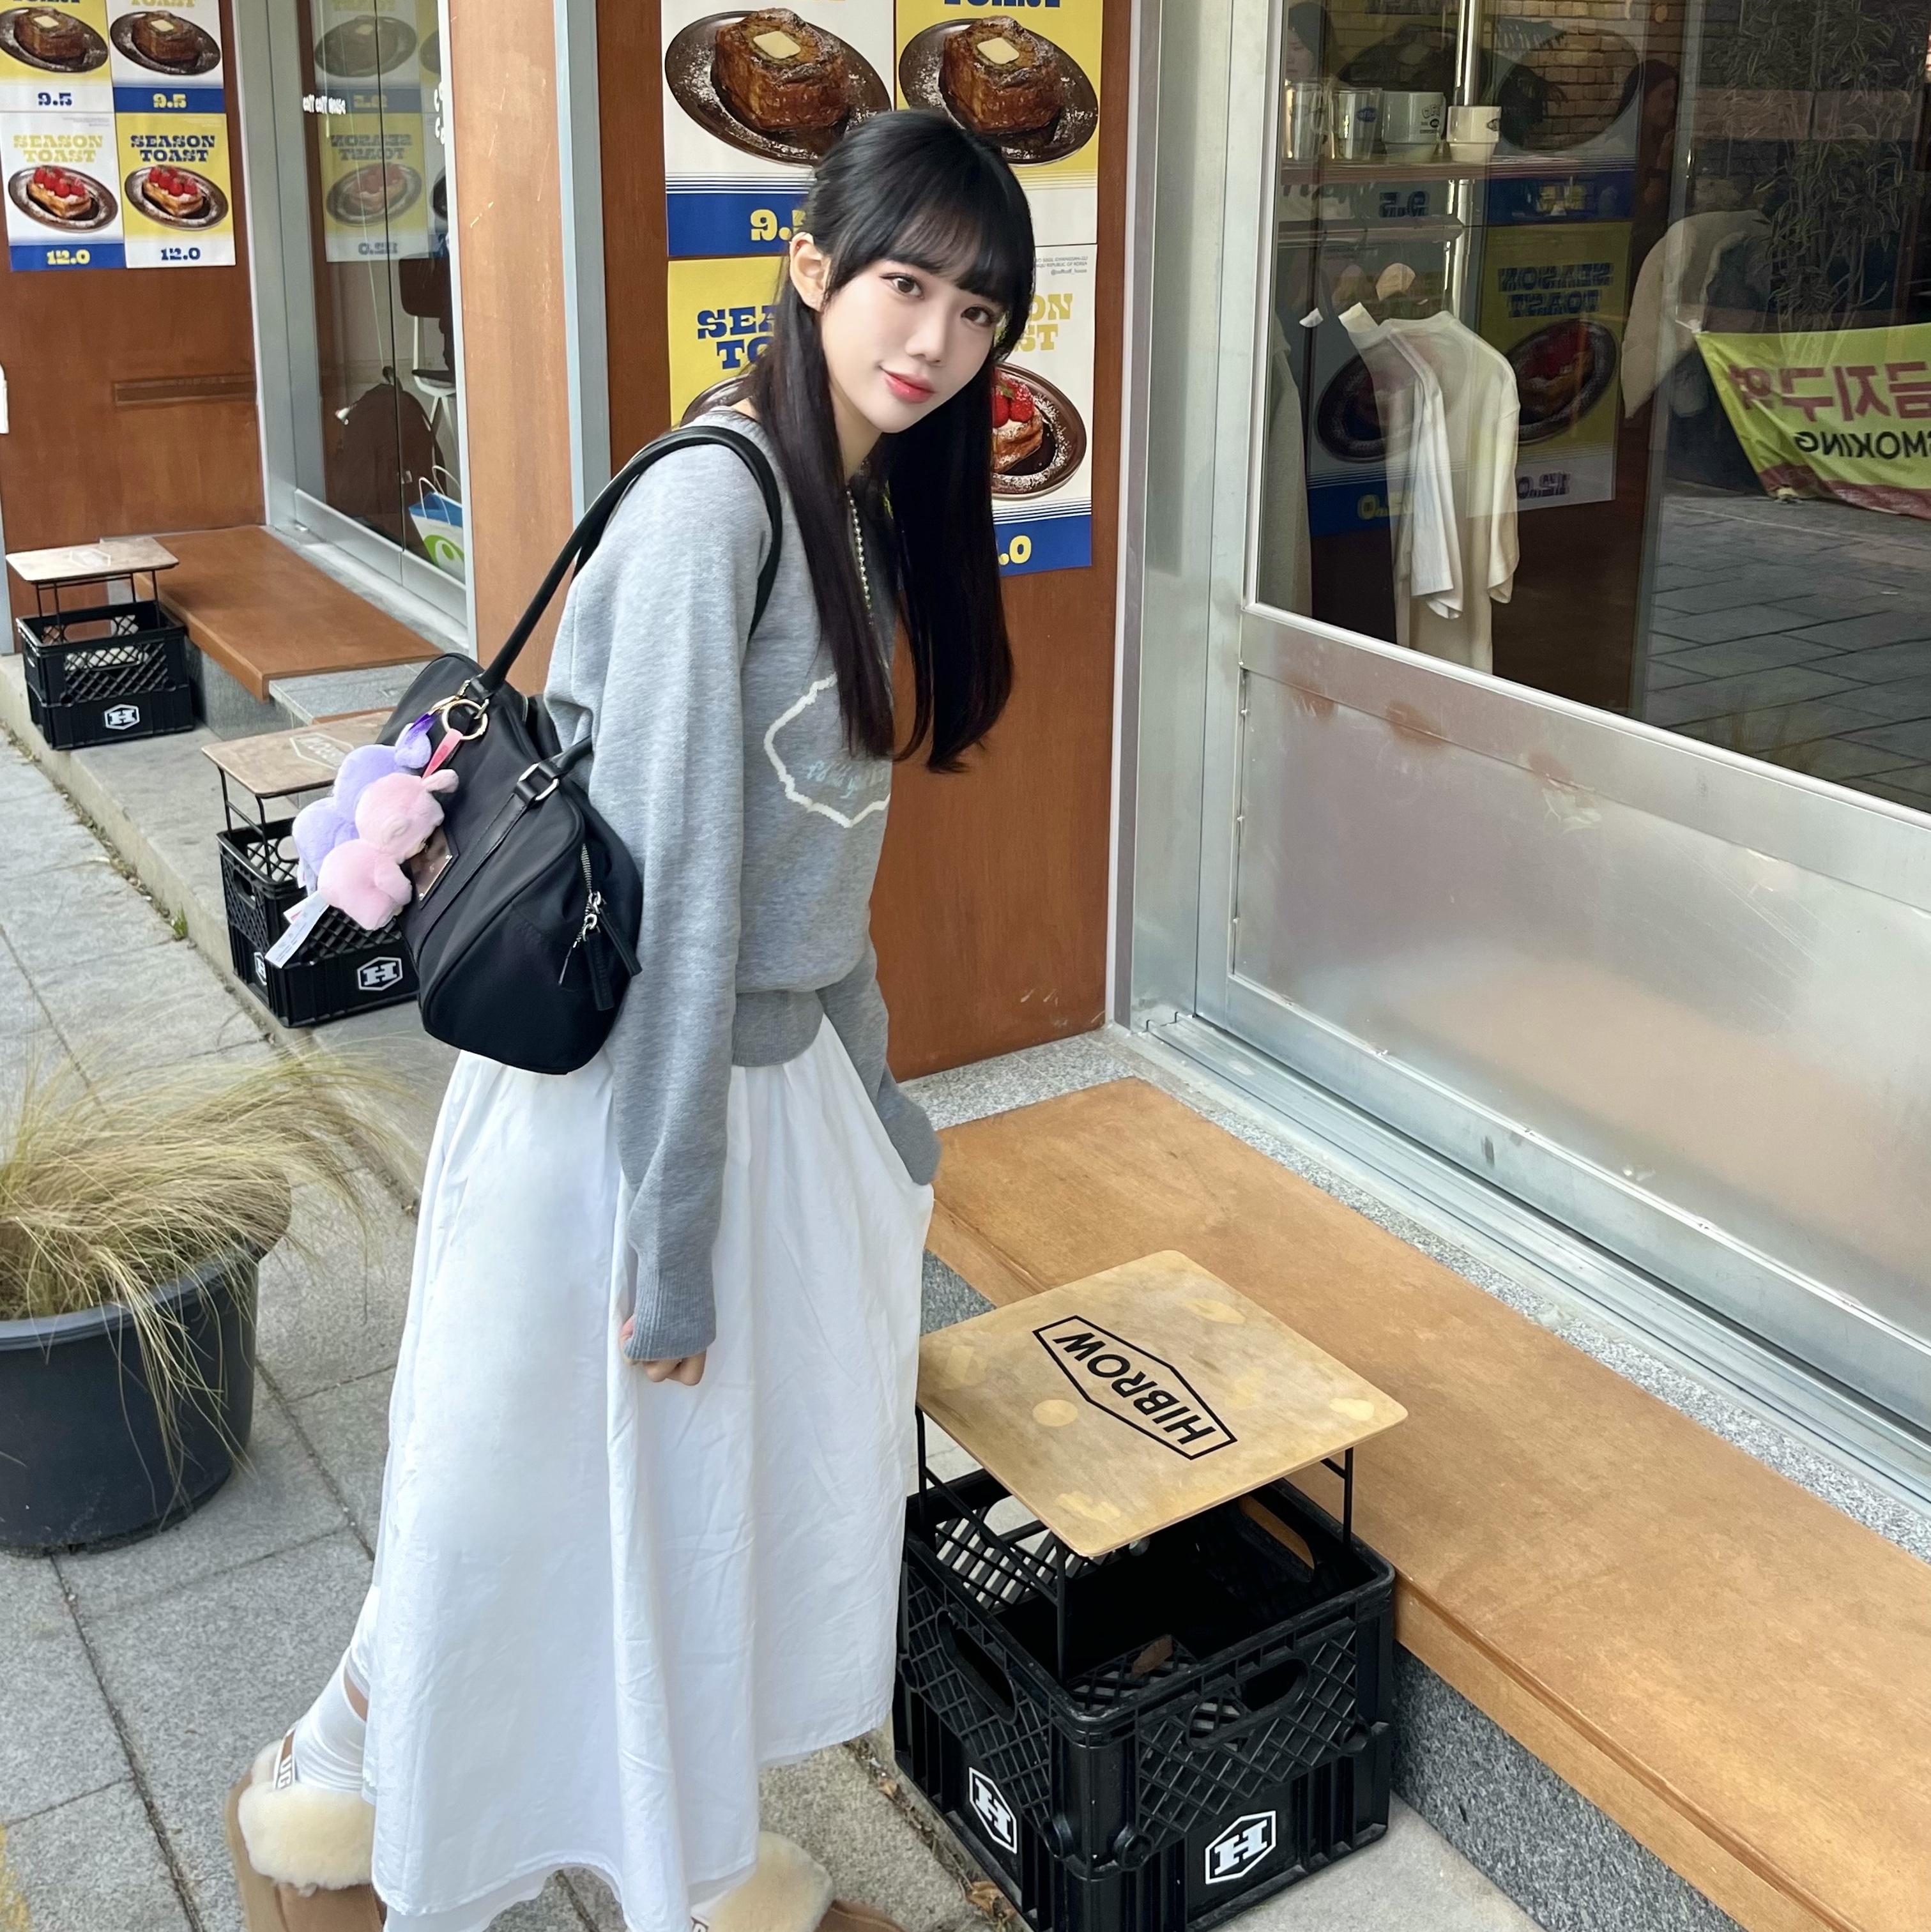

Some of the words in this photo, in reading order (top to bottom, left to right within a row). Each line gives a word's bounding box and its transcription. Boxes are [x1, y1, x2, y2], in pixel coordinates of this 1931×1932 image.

[38, 93, 72, 106] 9.5
[153, 93, 187, 108] 9.5
[13, 135, 103, 148] SEASON
[131, 135, 215, 148] SEASON
[24, 150, 96, 163] TOAST
[140, 150, 209, 162] TOAST
[47, 250, 91, 265] 12.0
[161, 248, 201, 261] 12.0
[363, 961, 397, 985] H
[1052, 1332, 1217, 1445] HIBROW
[975, 1777, 1011, 1843] H
[1214, 1820, 1268, 1875] H
